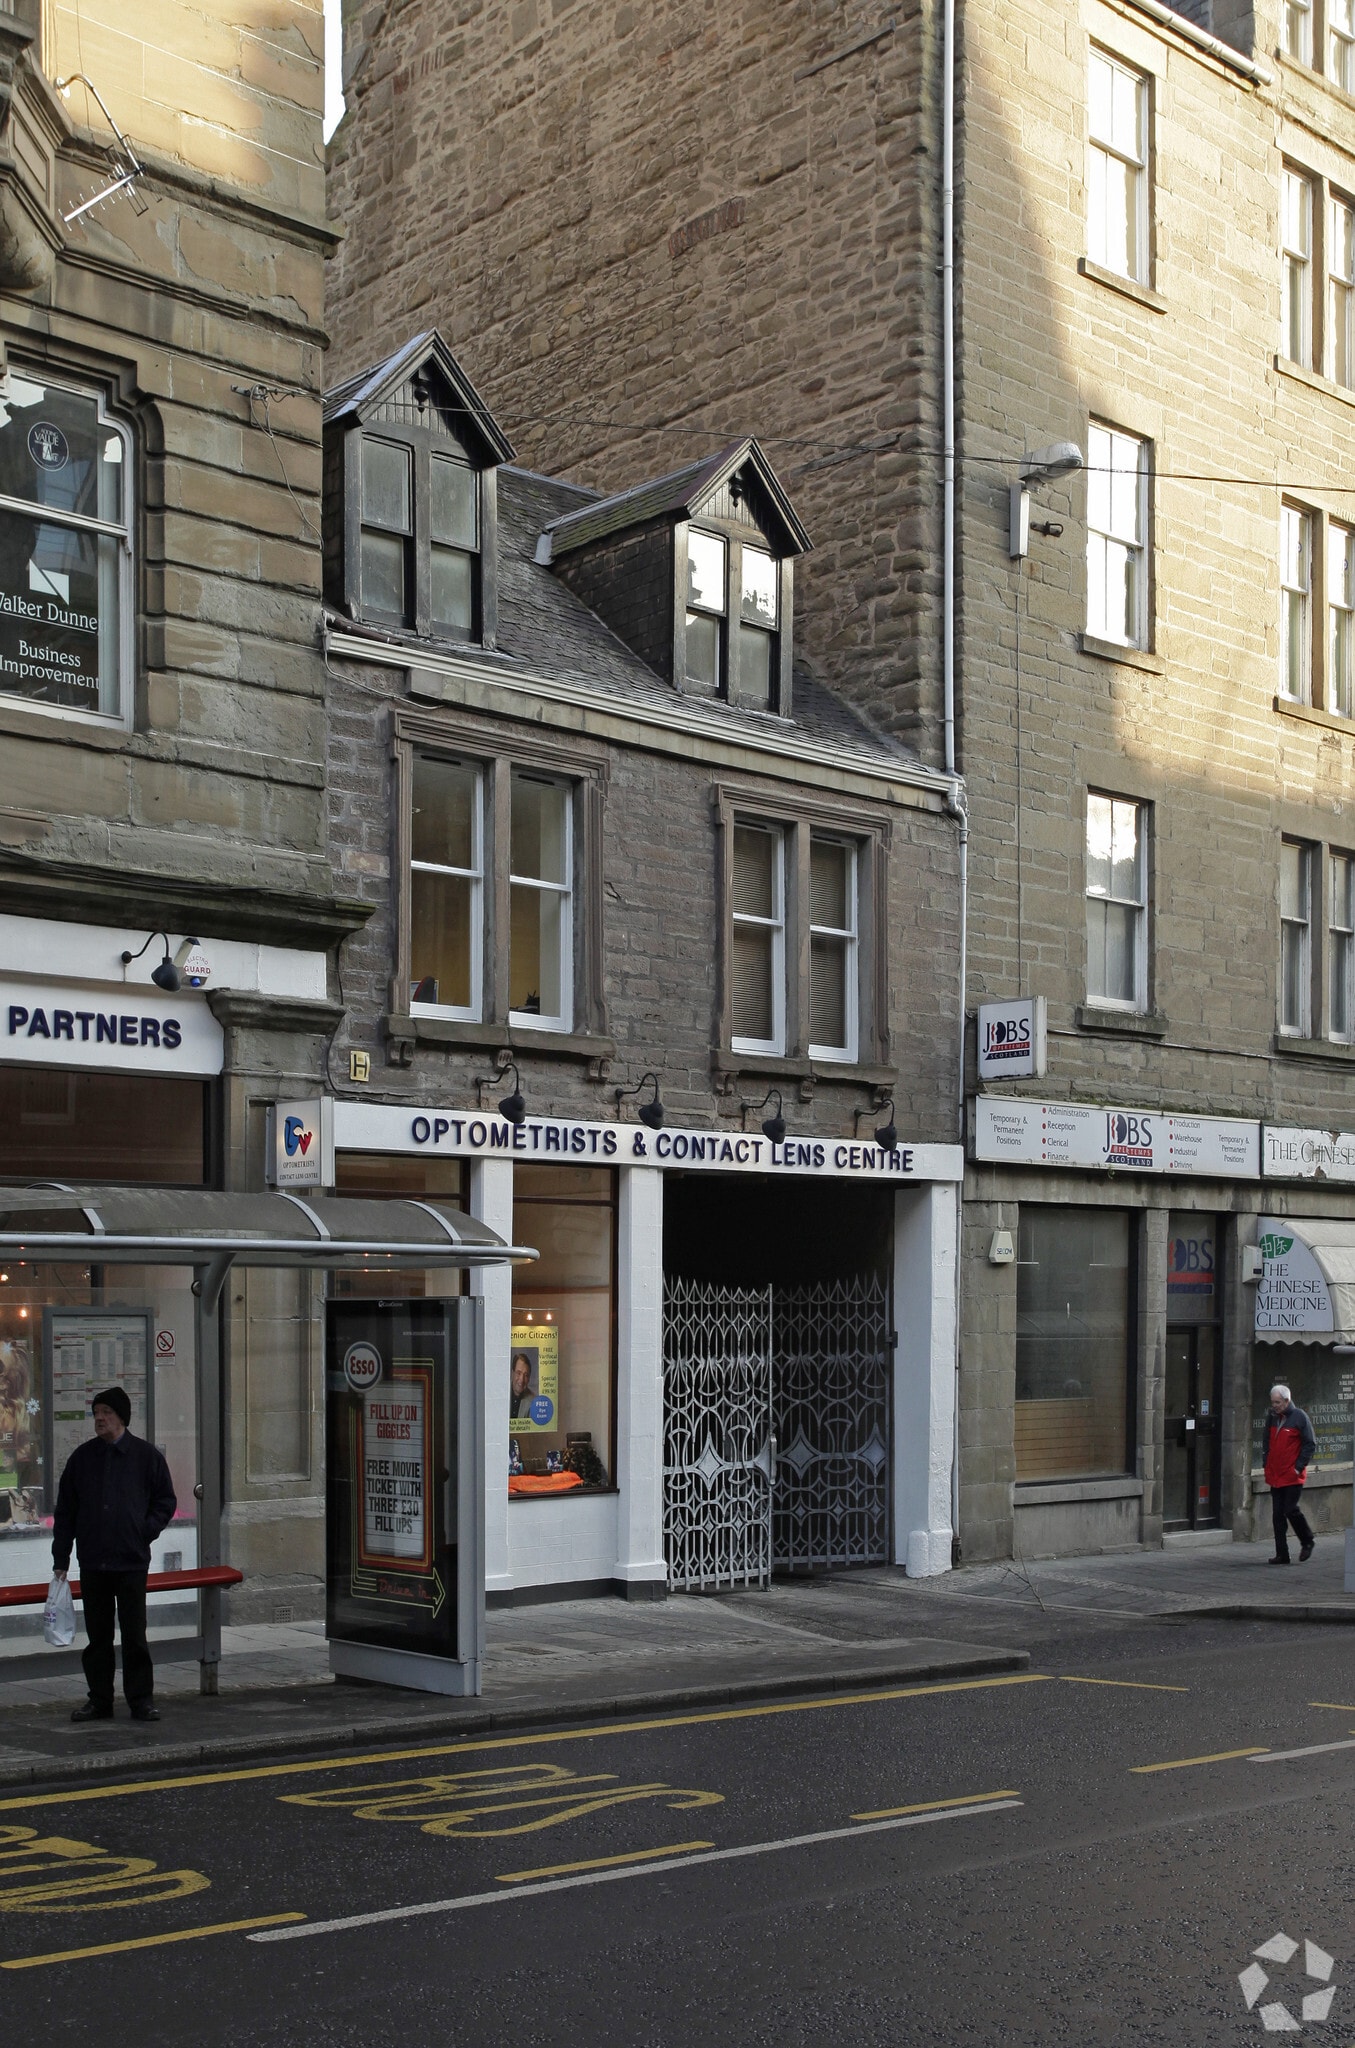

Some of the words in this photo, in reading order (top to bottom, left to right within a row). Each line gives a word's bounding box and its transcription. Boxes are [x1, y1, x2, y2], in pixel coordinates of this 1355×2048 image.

[19, 640, 81, 667] Business
[184, 966, 211, 974] GUARD
[9, 1005, 182, 1049] PARTNERS
[354, 1054, 367, 1078] H
[1048, 1107, 1090, 1118] Administration
[990, 1113, 1020, 1125] Temporary
[1174, 1119, 1200, 1128] Production
[994, 1125, 1024, 1135] Permanent
[1047, 1121, 1076, 1131] Reception
[996, 1136, 1022, 1145] Positions
[1047, 1138, 1069, 1147] Clerical
[1174, 1133, 1202, 1143] Warehouse
[1218, 1134, 1243, 1145] Temporary
[411, 1116, 618, 1154] OPTOMETRISTS
[632, 1132, 647, 1156] &
[656, 1133, 763, 1163] CONTACT
[772, 1142, 826, 1167] LENS
[834, 1145, 914, 1172] CENTRE
[1222, 1145, 1247, 1153] Permanent
[1047, 1152, 1069, 1161] Finance
[1174, 1147, 1197, 1156] Industrial
[1268, 1138, 1298, 1161] THE
[1301, 1141, 1355, 1165] CHINESE
[283, 1160, 315, 1168] OPTOMETRISTS
[1110, 1155, 1151, 1166] SCOTLAND
[1224, 1155, 1244, 1163] Positions
[1174, 1161, 1192, 1169] Driving
[1262, 1262, 1289, 1277] THE
[1257, 1278, 1321, 1294] CHINESE
[1257, 1295, 1327, 1310] MEDICINE
[1256, 1311, 1305, 1327] CLINIC
[370, 1404, 389, 1420] FILL
[391, 1404, 402, 1420] UP
[405, 1405, 417, 1421] ON
[377, 1422, 411, 1440] GIGGLES
[367, 1460, 389, 1476] FREE
[393, 1461, 420, 1478] MOVIE
[367, 1478, 398, 1495] TICKET
[399, 1480, 421, 1497] WITH
[369, 1497, 398, 1513] THREE
[402, 1500, 419, 1516] £30
[375, 1516, 394, 1532] FILL
[396, 1518, 413, 1534] UPS
